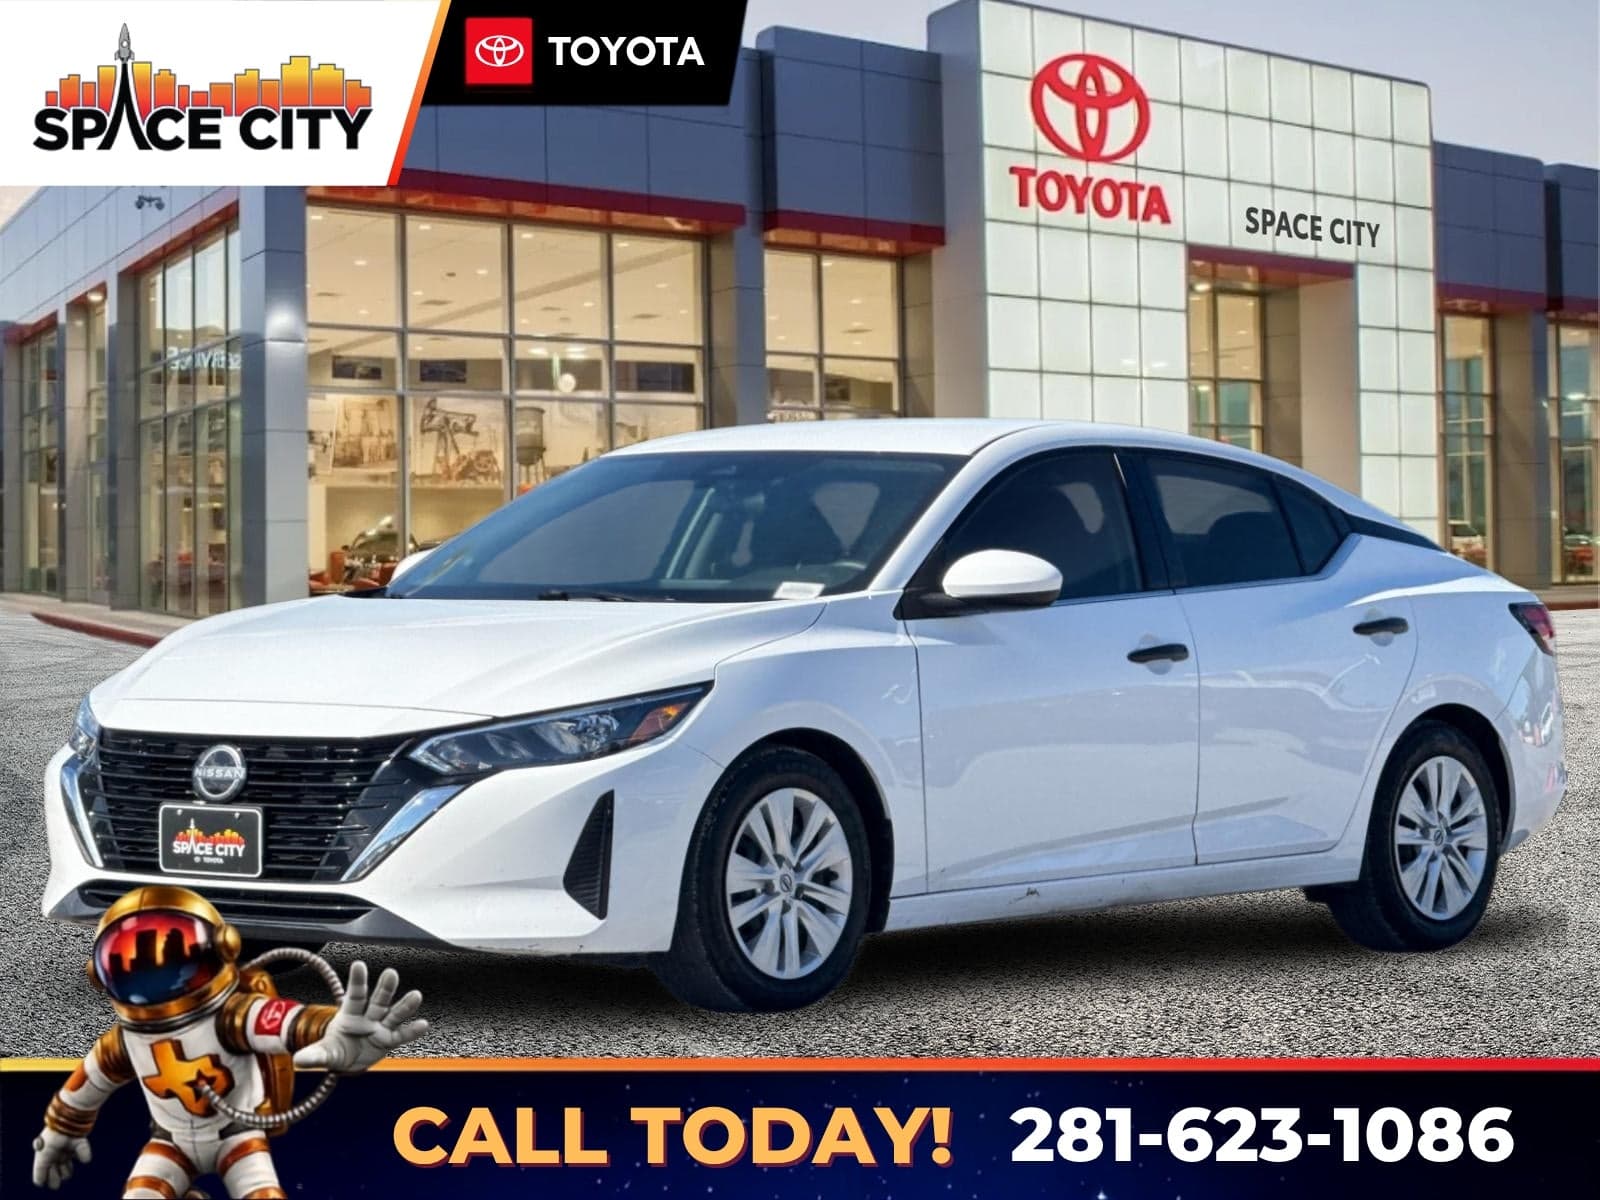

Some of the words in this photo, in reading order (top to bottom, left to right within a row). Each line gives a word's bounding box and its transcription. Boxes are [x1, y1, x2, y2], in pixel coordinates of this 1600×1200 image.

[1010, 166, 1172, 225] TOYOTA
[1245, 206, 1322, 241] SPACE
[1329, 218, 1380, 248] CITY
[193, 766, 246, 780] NISSAN
[173, 841, 213, 855] SPACE
[215, 843, 246, 857] CITY
